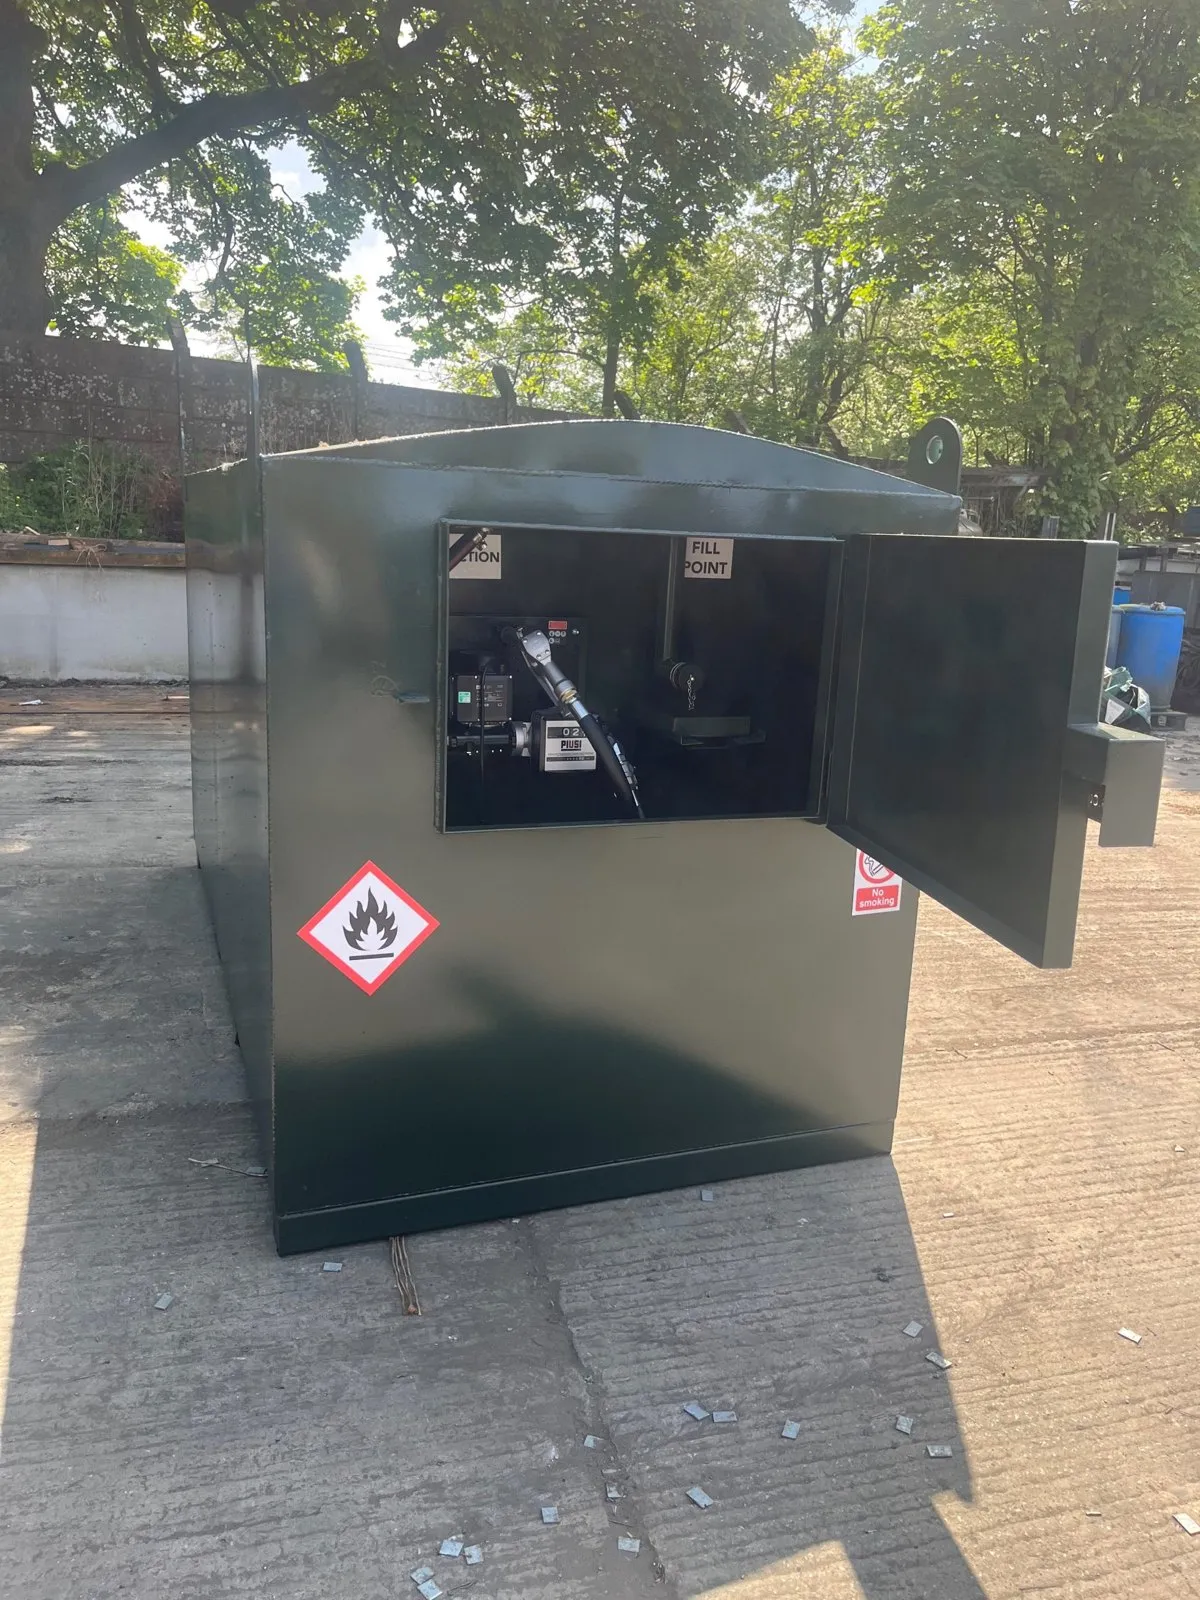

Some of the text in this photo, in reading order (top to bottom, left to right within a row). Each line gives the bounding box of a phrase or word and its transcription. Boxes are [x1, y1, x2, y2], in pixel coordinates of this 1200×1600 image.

[692, 541, 720, 555] FILL
[461, 551, 500, 563] TION
[562, 727, 585, 737] 02
[560, 740, 582, 749] PIUSI
[872, 889, 884, 897] No
[859, 898, 895, 908] smoking
